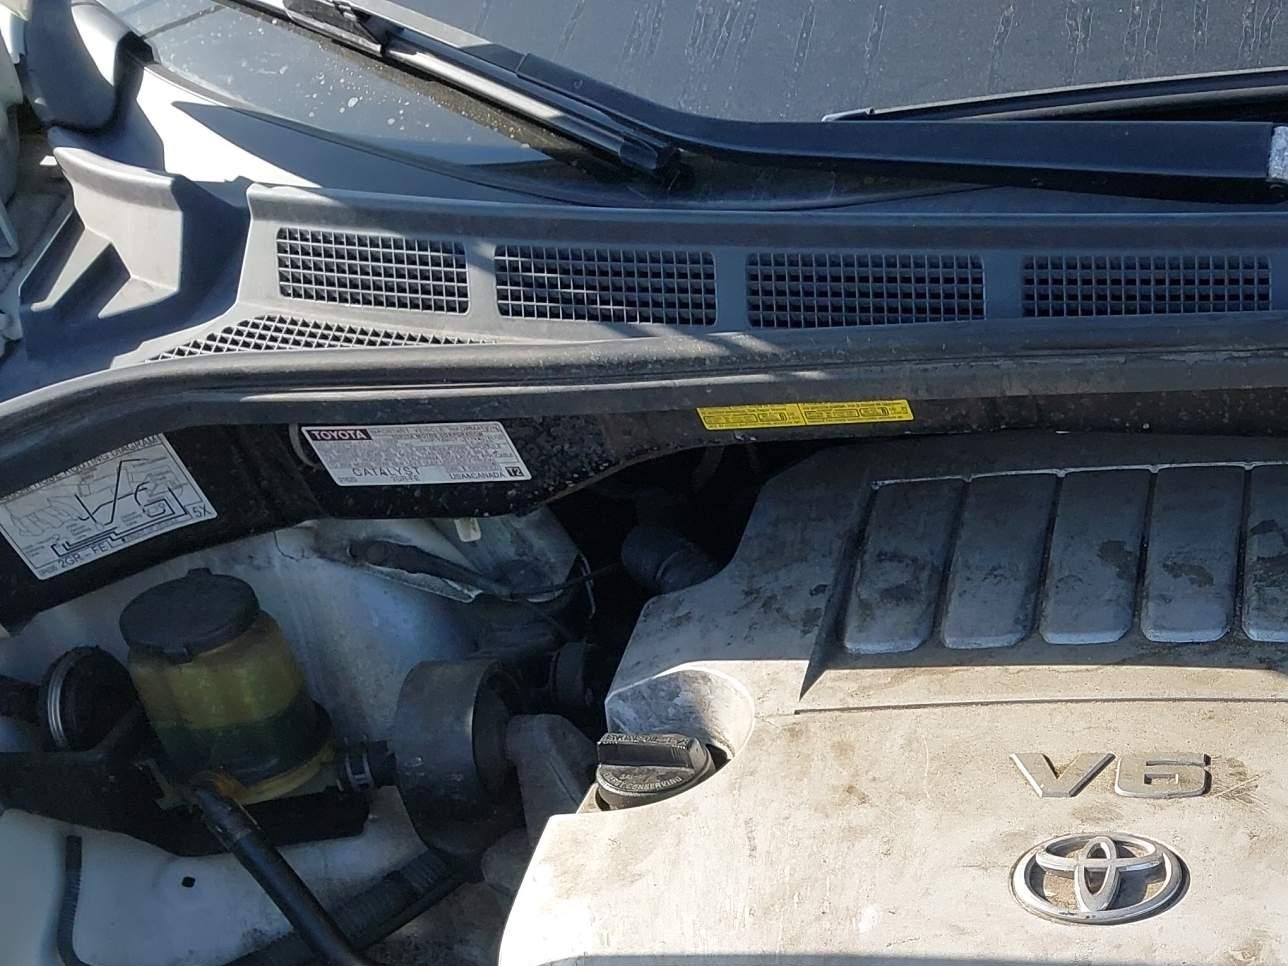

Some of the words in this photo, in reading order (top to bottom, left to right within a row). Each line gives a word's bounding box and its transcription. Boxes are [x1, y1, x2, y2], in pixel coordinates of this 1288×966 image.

[312, 430, 368, 441] TOYOTA
[352, 465, 420, 477] CATALYST
[193, 504, 212, 519] 5X
[1009, 752, 1212, 799] V6
